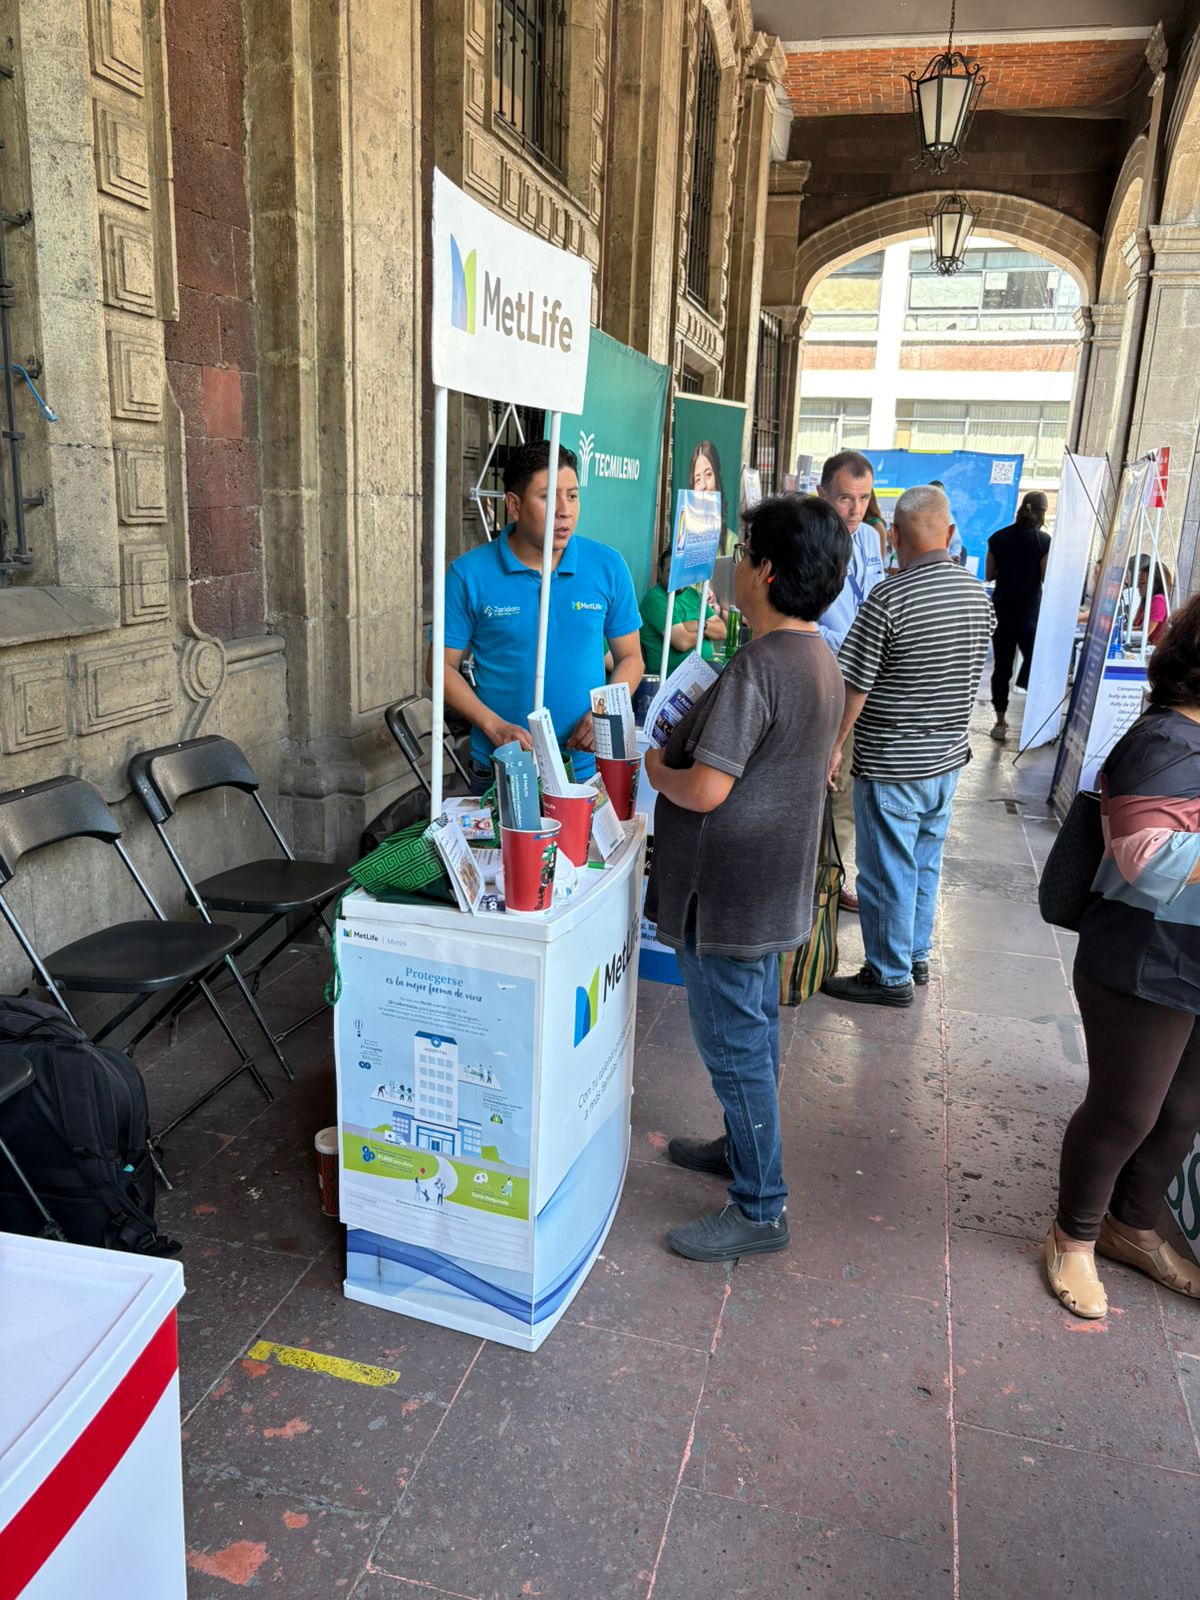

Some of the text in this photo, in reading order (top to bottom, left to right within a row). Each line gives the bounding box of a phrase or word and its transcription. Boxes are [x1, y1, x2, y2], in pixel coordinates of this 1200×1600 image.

[482, 270, 573, 353] MetLife
[594, 452, 640, 481] TECMILENIO
[580, 601, 602, 610] MetLife
[353, 931, 379, 942] MetLife
[405, 966, 464, 988] Protegerse
[385, 976, 482, 1002] es la mejor forma de vivir
[424, 1047, 448, 1056] HOSPITAL
